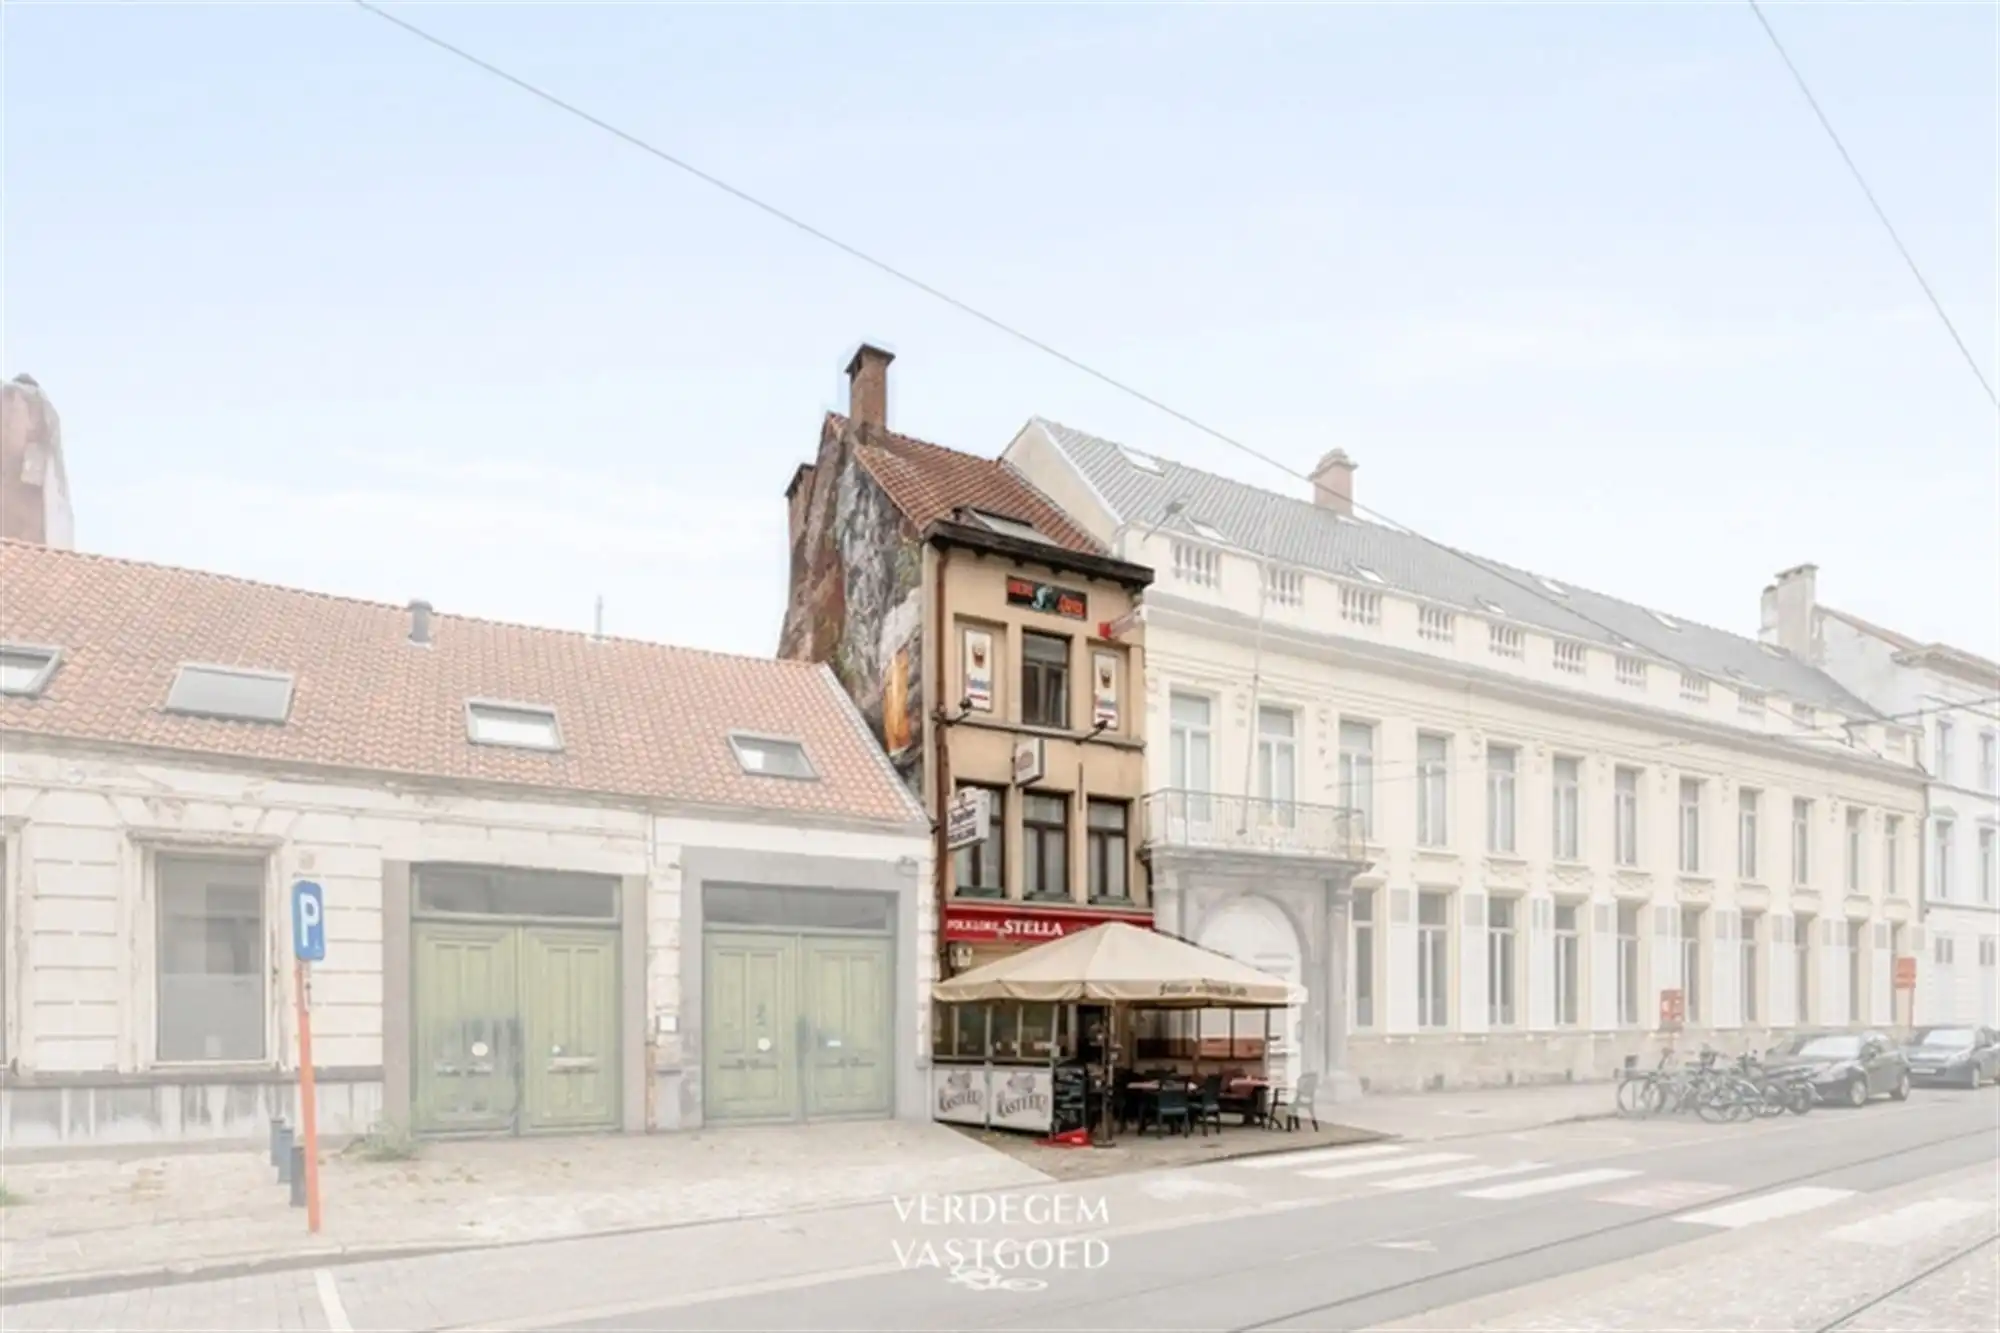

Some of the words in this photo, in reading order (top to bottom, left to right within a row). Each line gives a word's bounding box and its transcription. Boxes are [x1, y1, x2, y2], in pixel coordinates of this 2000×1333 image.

[299, 891, 320, 949] P
[946, 919, 999, 932] FOLKLORE
[1004, 919, 1065, 937] STELLA
